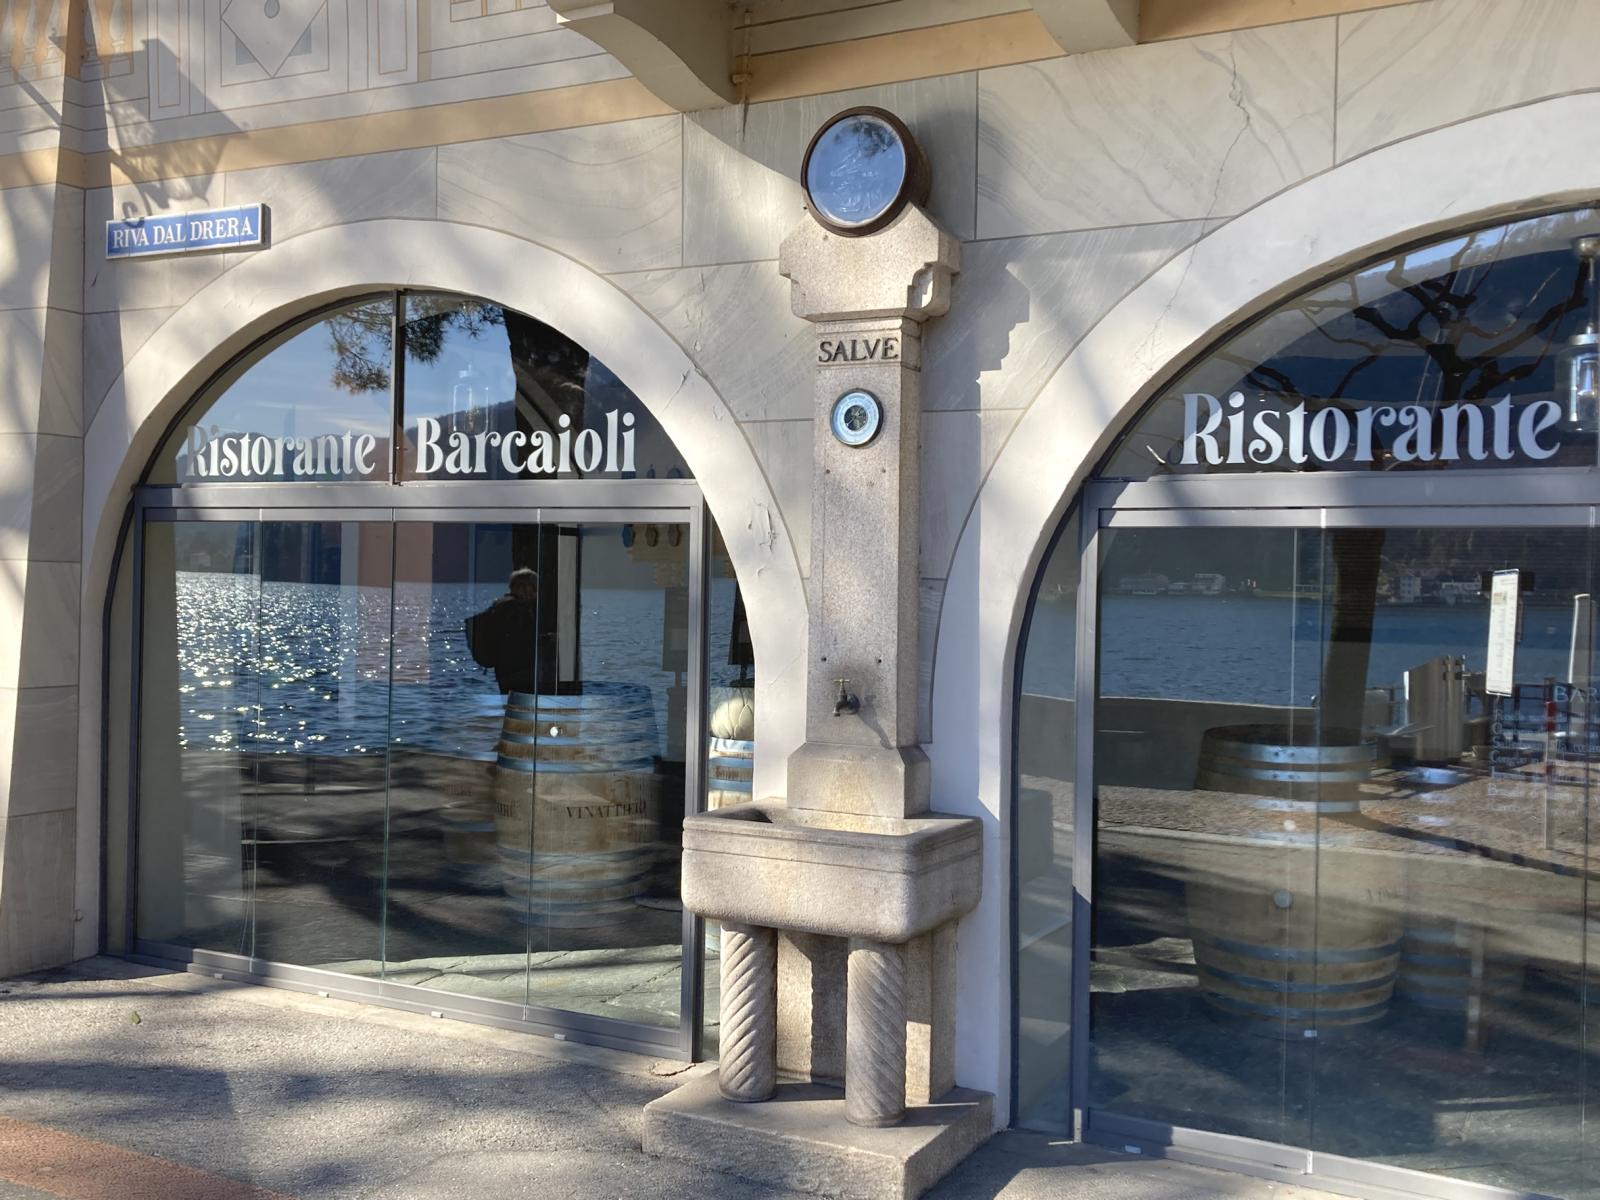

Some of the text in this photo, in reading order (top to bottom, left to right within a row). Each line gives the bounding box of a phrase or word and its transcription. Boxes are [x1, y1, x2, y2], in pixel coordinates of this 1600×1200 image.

[113, 216, 253, 249] RIVA DAL DRERA
[818, 336, 900, 363] SALVE
[185, 408, 636, 478] Ristorante Barcaioli
[1180, 391, 1562, 465] Ristorante
